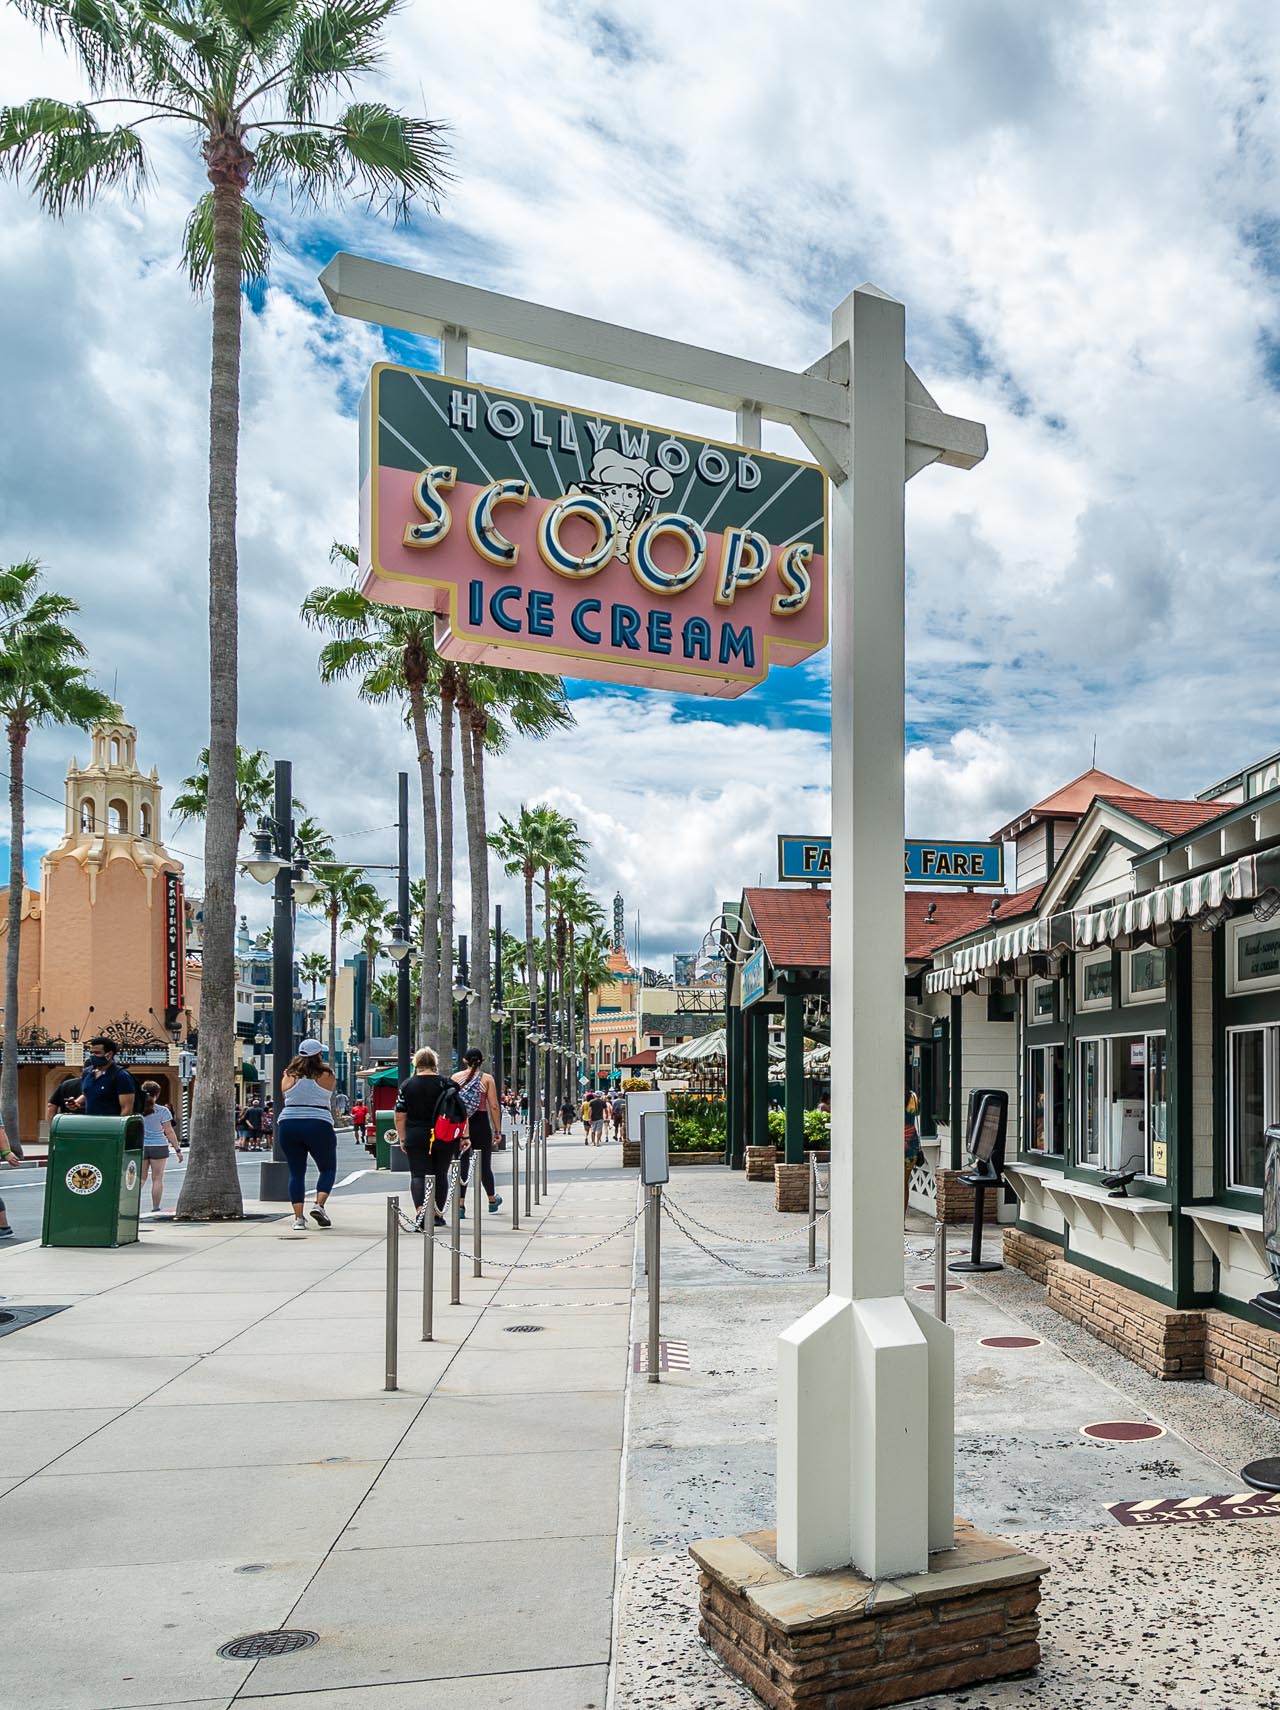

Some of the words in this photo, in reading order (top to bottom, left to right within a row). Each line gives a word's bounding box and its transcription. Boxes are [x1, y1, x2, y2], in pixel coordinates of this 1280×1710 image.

[450, 389, 762, 491] HOLLYWOOD
[403, 465, 814, 616] SCOOPS
[469, 579, 554, 636] ICE
[571, 598, 755, 668] CREAM
[921, 849, 985, 877] FARE
[168, 880, 177, 943] CARTHAY
[169, 951, 177, 1006] CIRCLE
[100, 1022, 154, 1041] CARTHAY
[1129, 1508, 1221, 1523] EXIT
